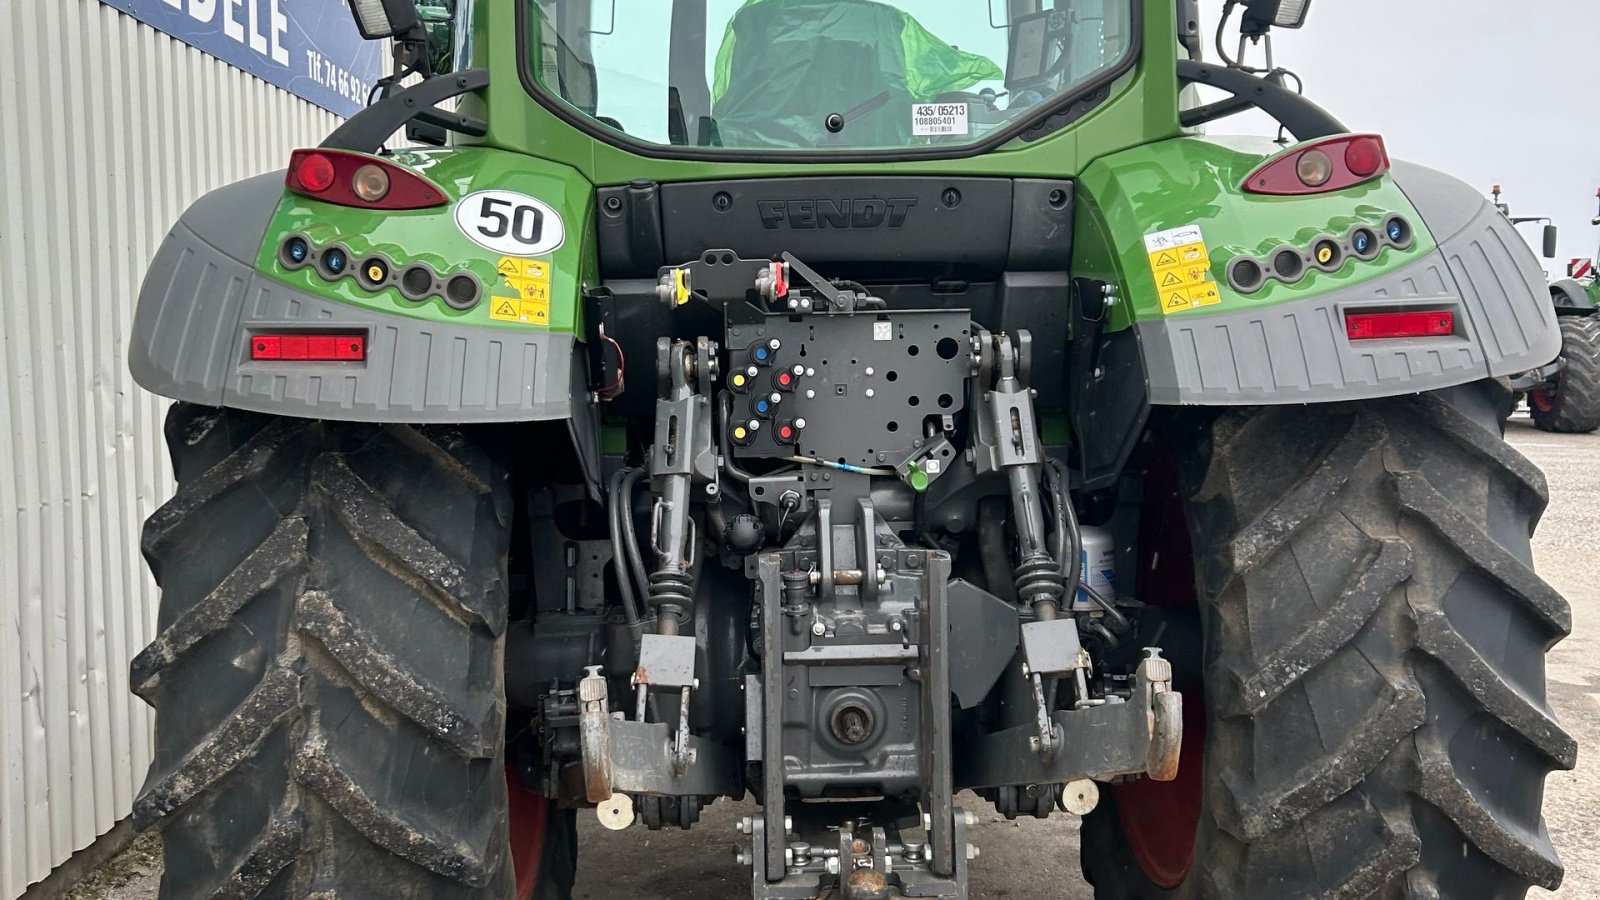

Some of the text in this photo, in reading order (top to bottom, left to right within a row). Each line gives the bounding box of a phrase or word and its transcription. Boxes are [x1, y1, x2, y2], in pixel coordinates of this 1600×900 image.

[306, 49, 324, 85] Tlf.
[324, 60, 337, 91] 74
[338, 67, 349, 98] 66
[350, 75, 361, 105] 92
[915, 117, 956, 126] 108805401
[476, 196, 544, 245] 50
[757, 198, 918, 229] FENDT
